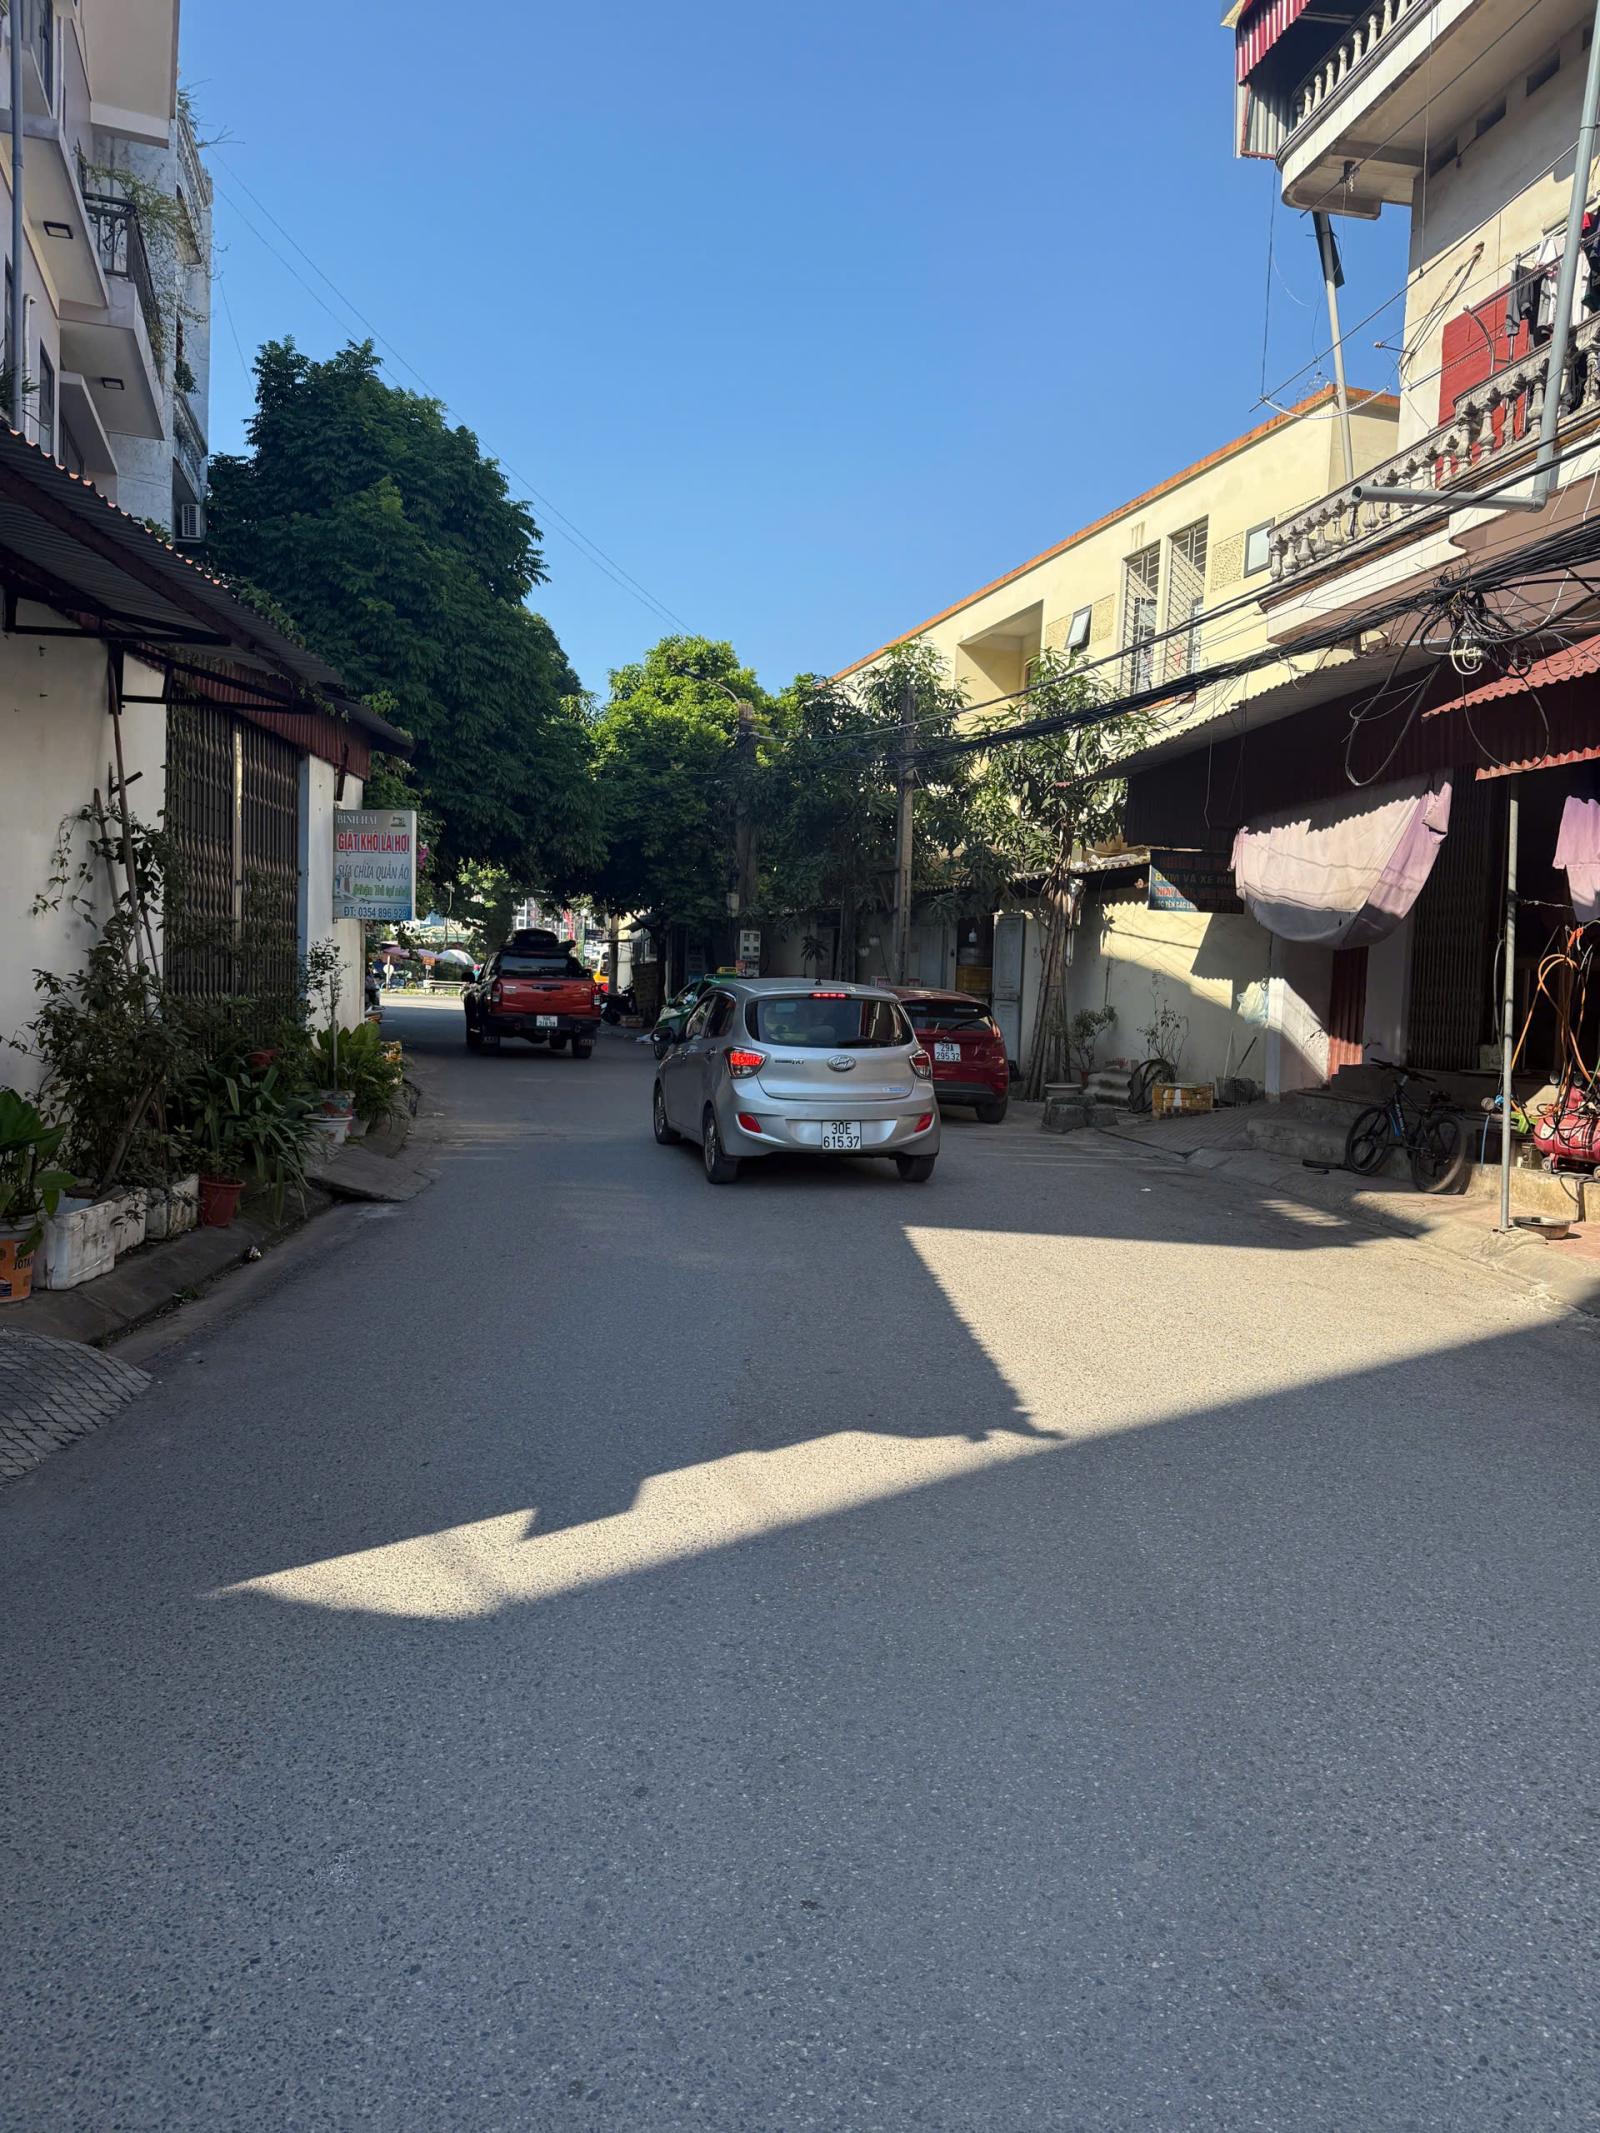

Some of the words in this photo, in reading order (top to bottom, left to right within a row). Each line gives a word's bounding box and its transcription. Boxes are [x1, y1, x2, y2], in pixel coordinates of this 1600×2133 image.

[358, 906, 376, 918] 0354
[378, 907, 392, 918] 896
[940, 1044, 954, 1052] 29A
[831, 1122, 852, 1135] 30E
[823, 1135, 860, 1149] 615.37
